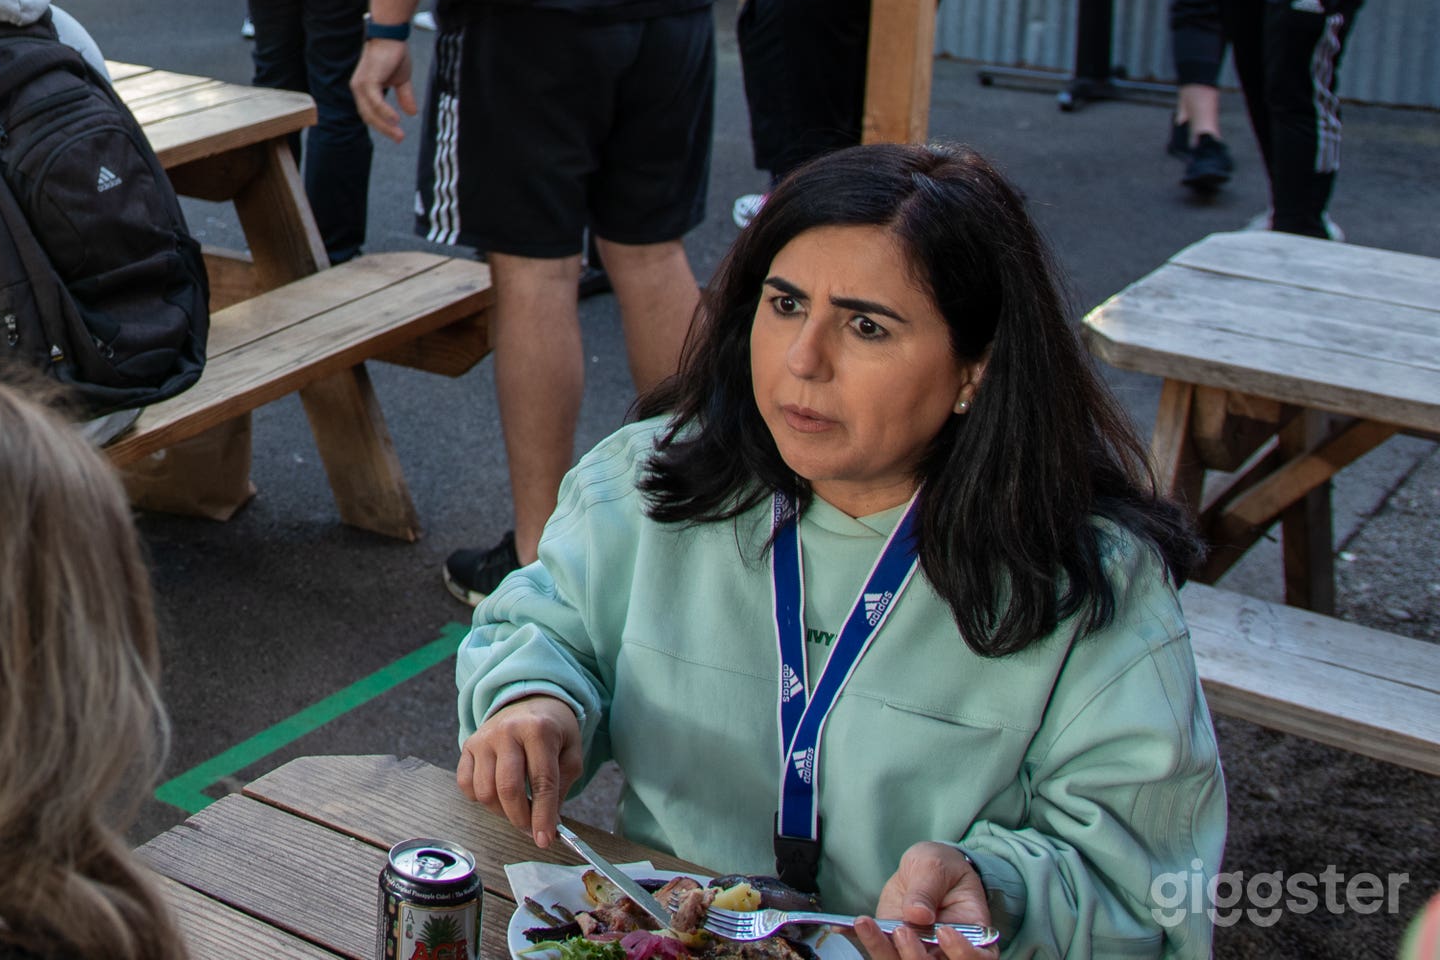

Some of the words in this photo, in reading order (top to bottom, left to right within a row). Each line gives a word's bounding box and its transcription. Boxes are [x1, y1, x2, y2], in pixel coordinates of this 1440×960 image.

[868, 591, 893, 626] adidas
[807, 628, 835, 646] IVY
[803, 746, 814, 784] adidas
[405, 910, 415, 924] A
